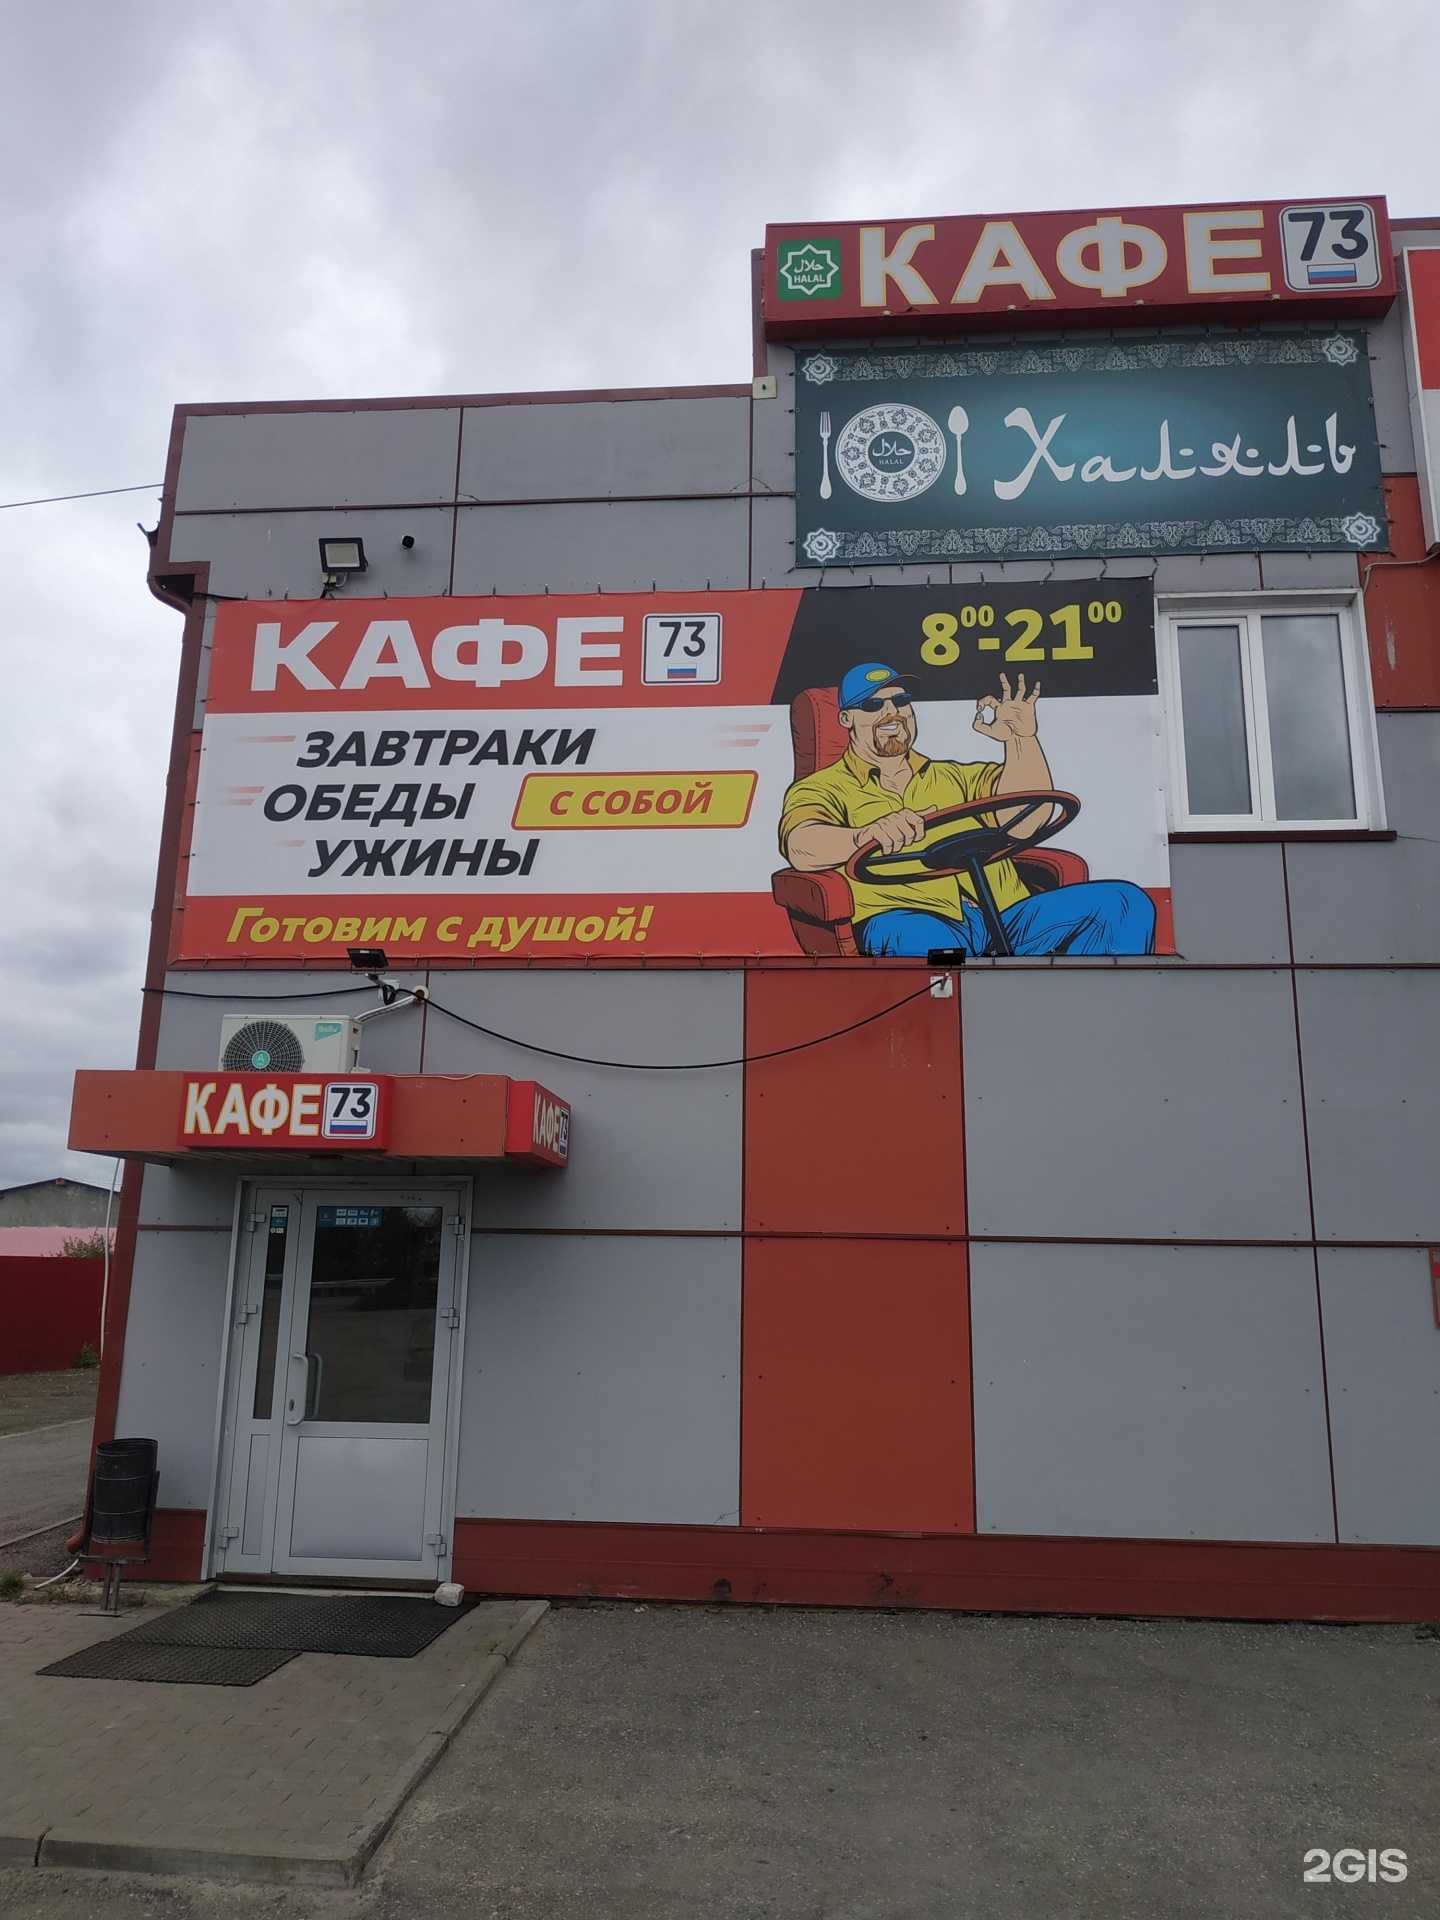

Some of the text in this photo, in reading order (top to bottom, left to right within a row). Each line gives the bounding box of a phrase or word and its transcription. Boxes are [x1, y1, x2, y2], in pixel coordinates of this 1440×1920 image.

[793, 274, 825, 284] HALAL
[858, 209, 1368, 307] КАФЕ 73
[994, 407, 1356, 500] Халяль
[250, 616, 707, 692] КАФЕ 73
[296, 727, 597, 768] ЗАВТРАКИ
[262, 782, 477, 828] ОБЕДЫ
[580, 781, 714, 816] СОБОЙ
[307, 838, 540, 878] УЖИНЫ
[226, 905, 655, 952] Готовим с душой!
[183, 1082, 372, 1136] КАФЕ 73
[532, 1089, 560, 1153] КАФЕ
